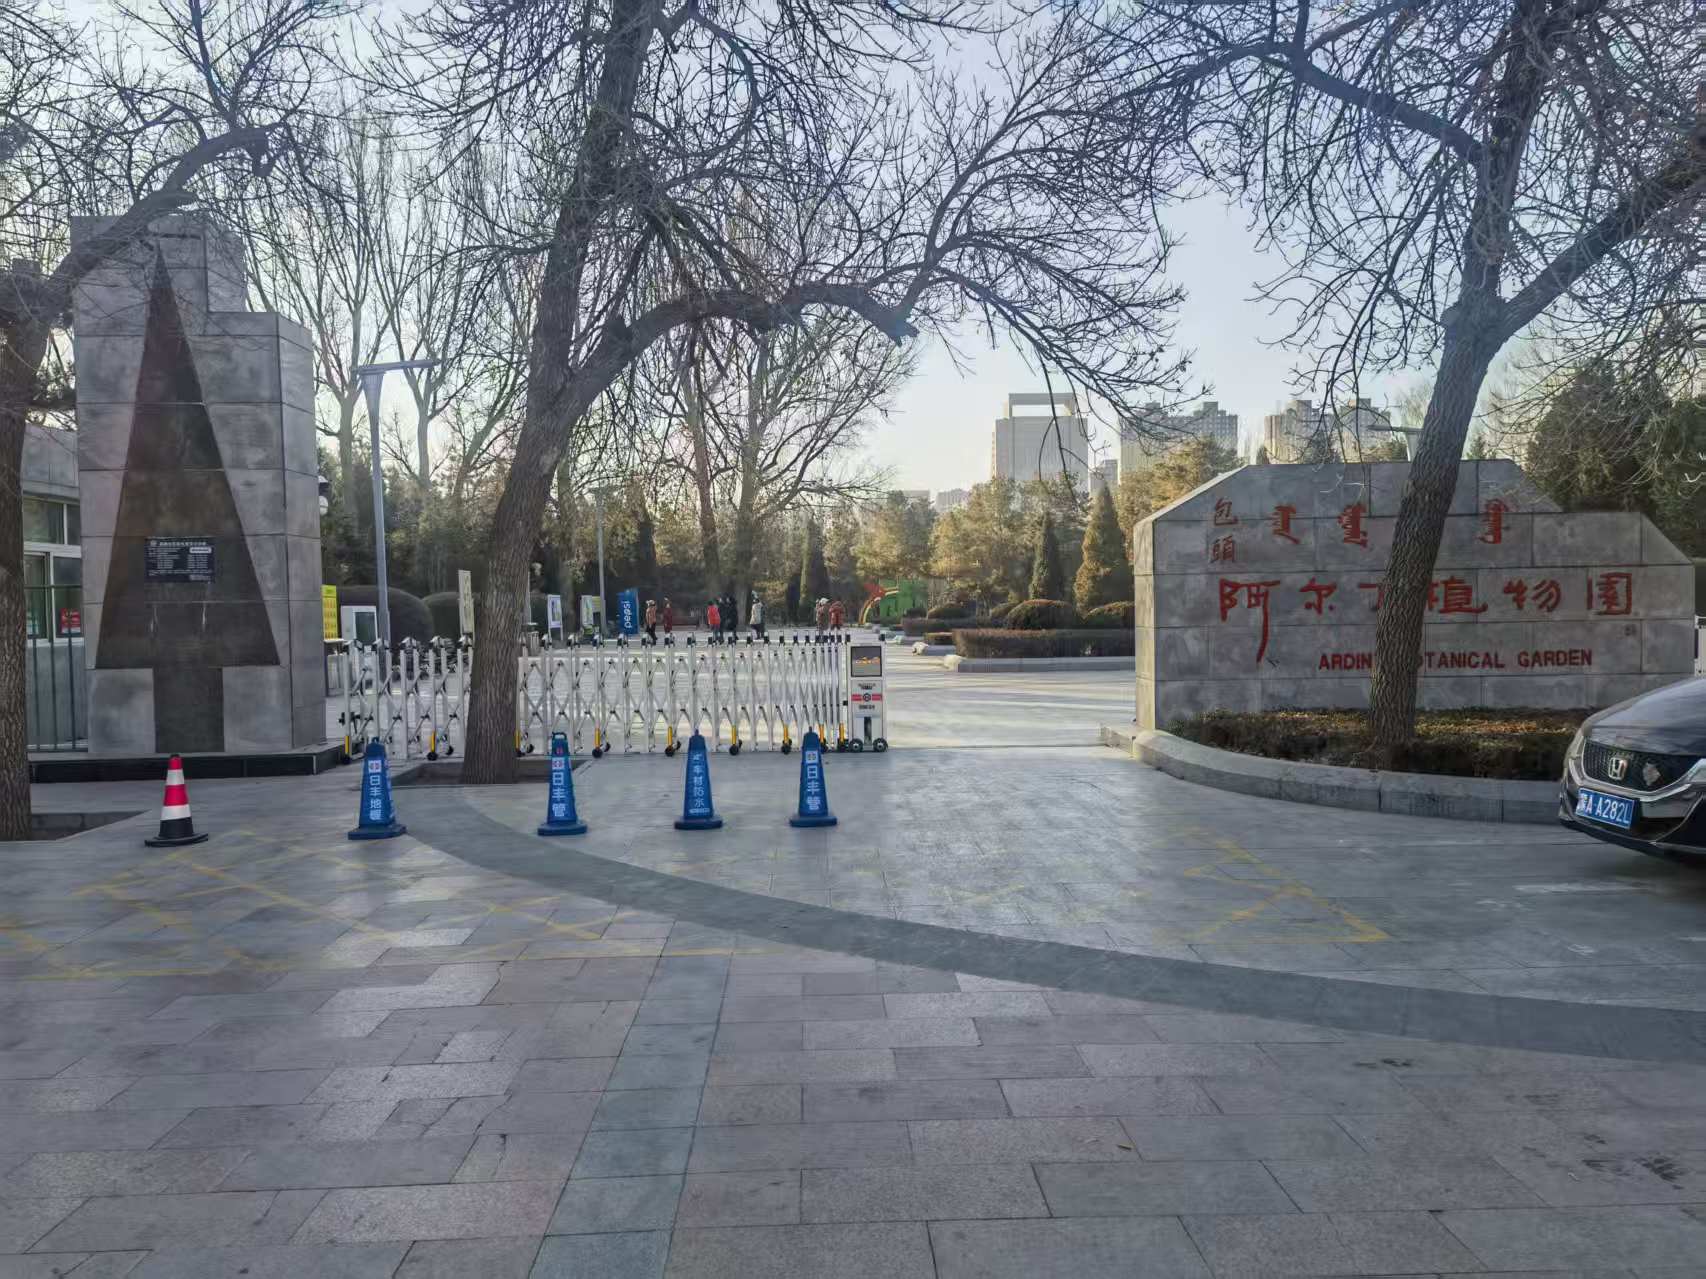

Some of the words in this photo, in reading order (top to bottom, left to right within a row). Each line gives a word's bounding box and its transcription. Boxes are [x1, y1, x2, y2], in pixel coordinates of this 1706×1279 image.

[1319, 652, 1377, 671] ARDIN
[1417, 651, 1505, 669] TANICAL
[1517, 649, 1592, 668] GARDEN
